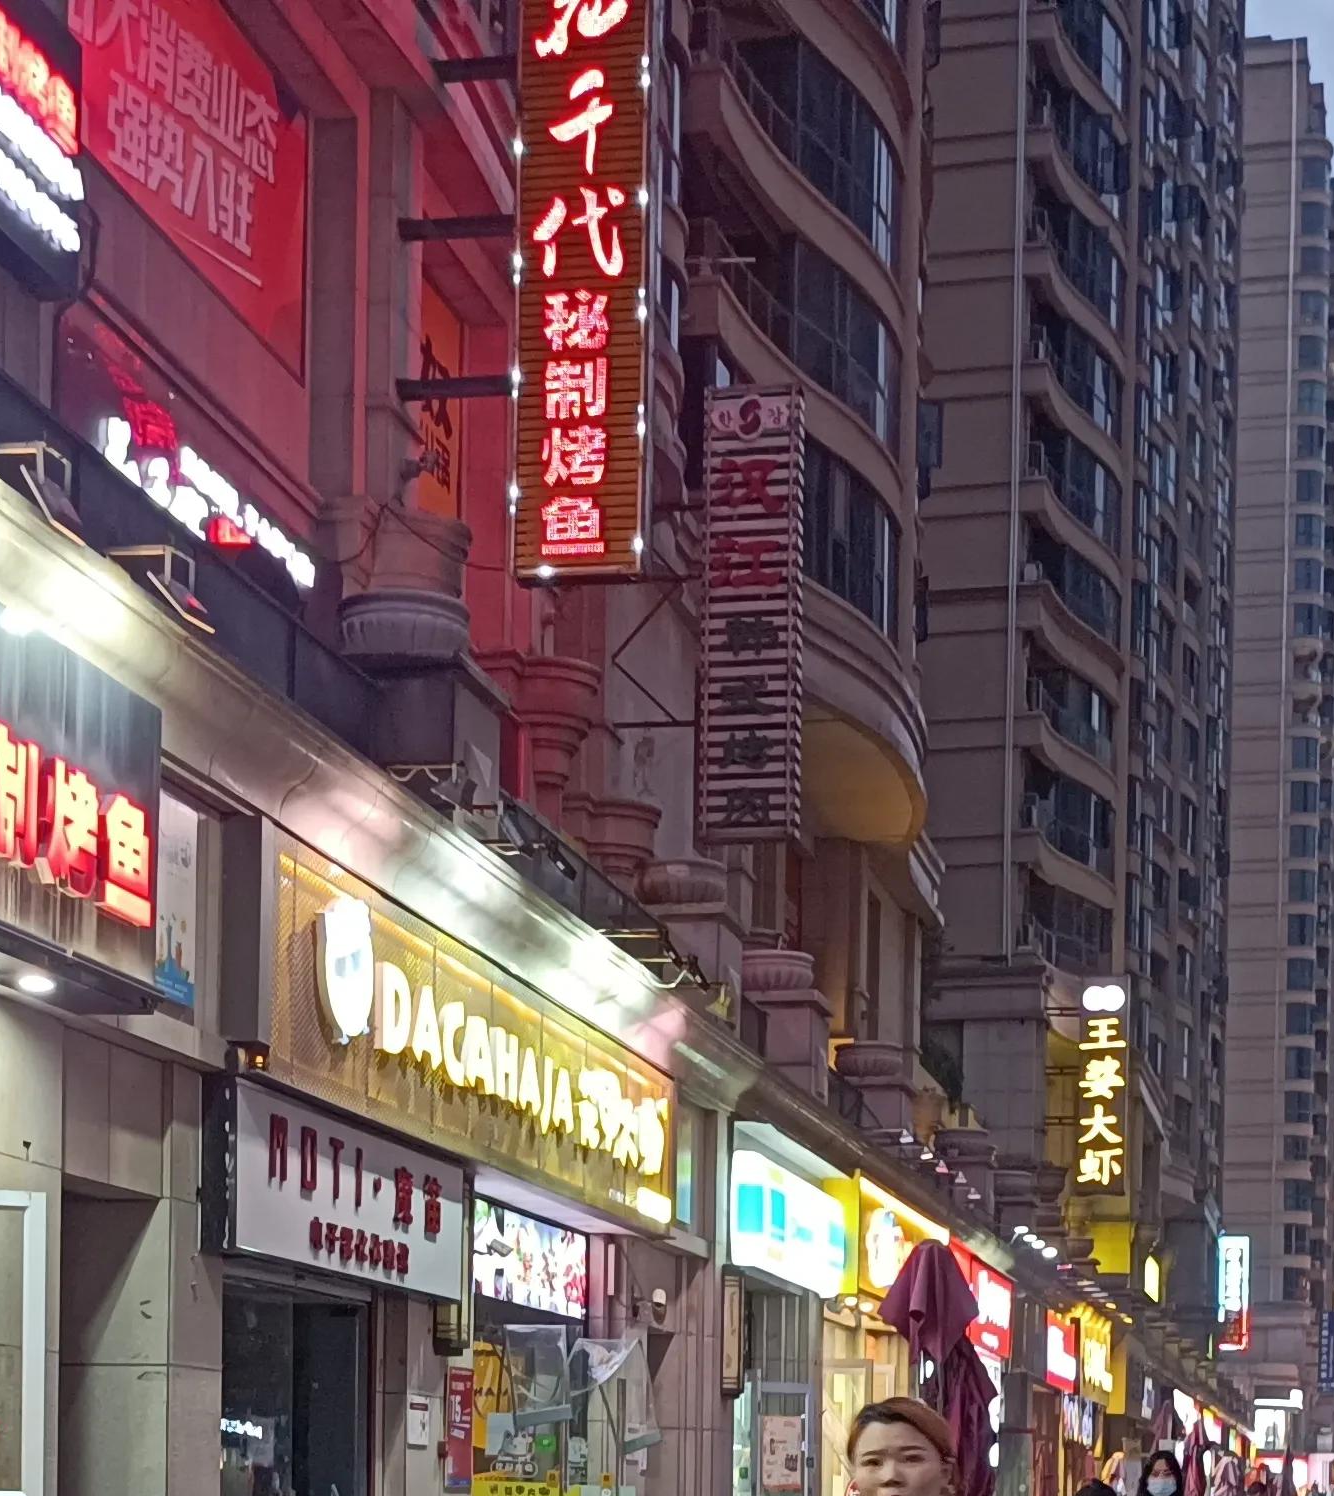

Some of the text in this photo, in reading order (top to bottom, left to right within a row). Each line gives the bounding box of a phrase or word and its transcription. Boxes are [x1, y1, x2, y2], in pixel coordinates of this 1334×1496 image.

[107, 68, 253, 259] 强势入驻
[541, 288, 610, 557] 秘制烤鱼
[710, 458, 786, 588] 汉江
[376, 961, 575, 1135] DACAHAJA
